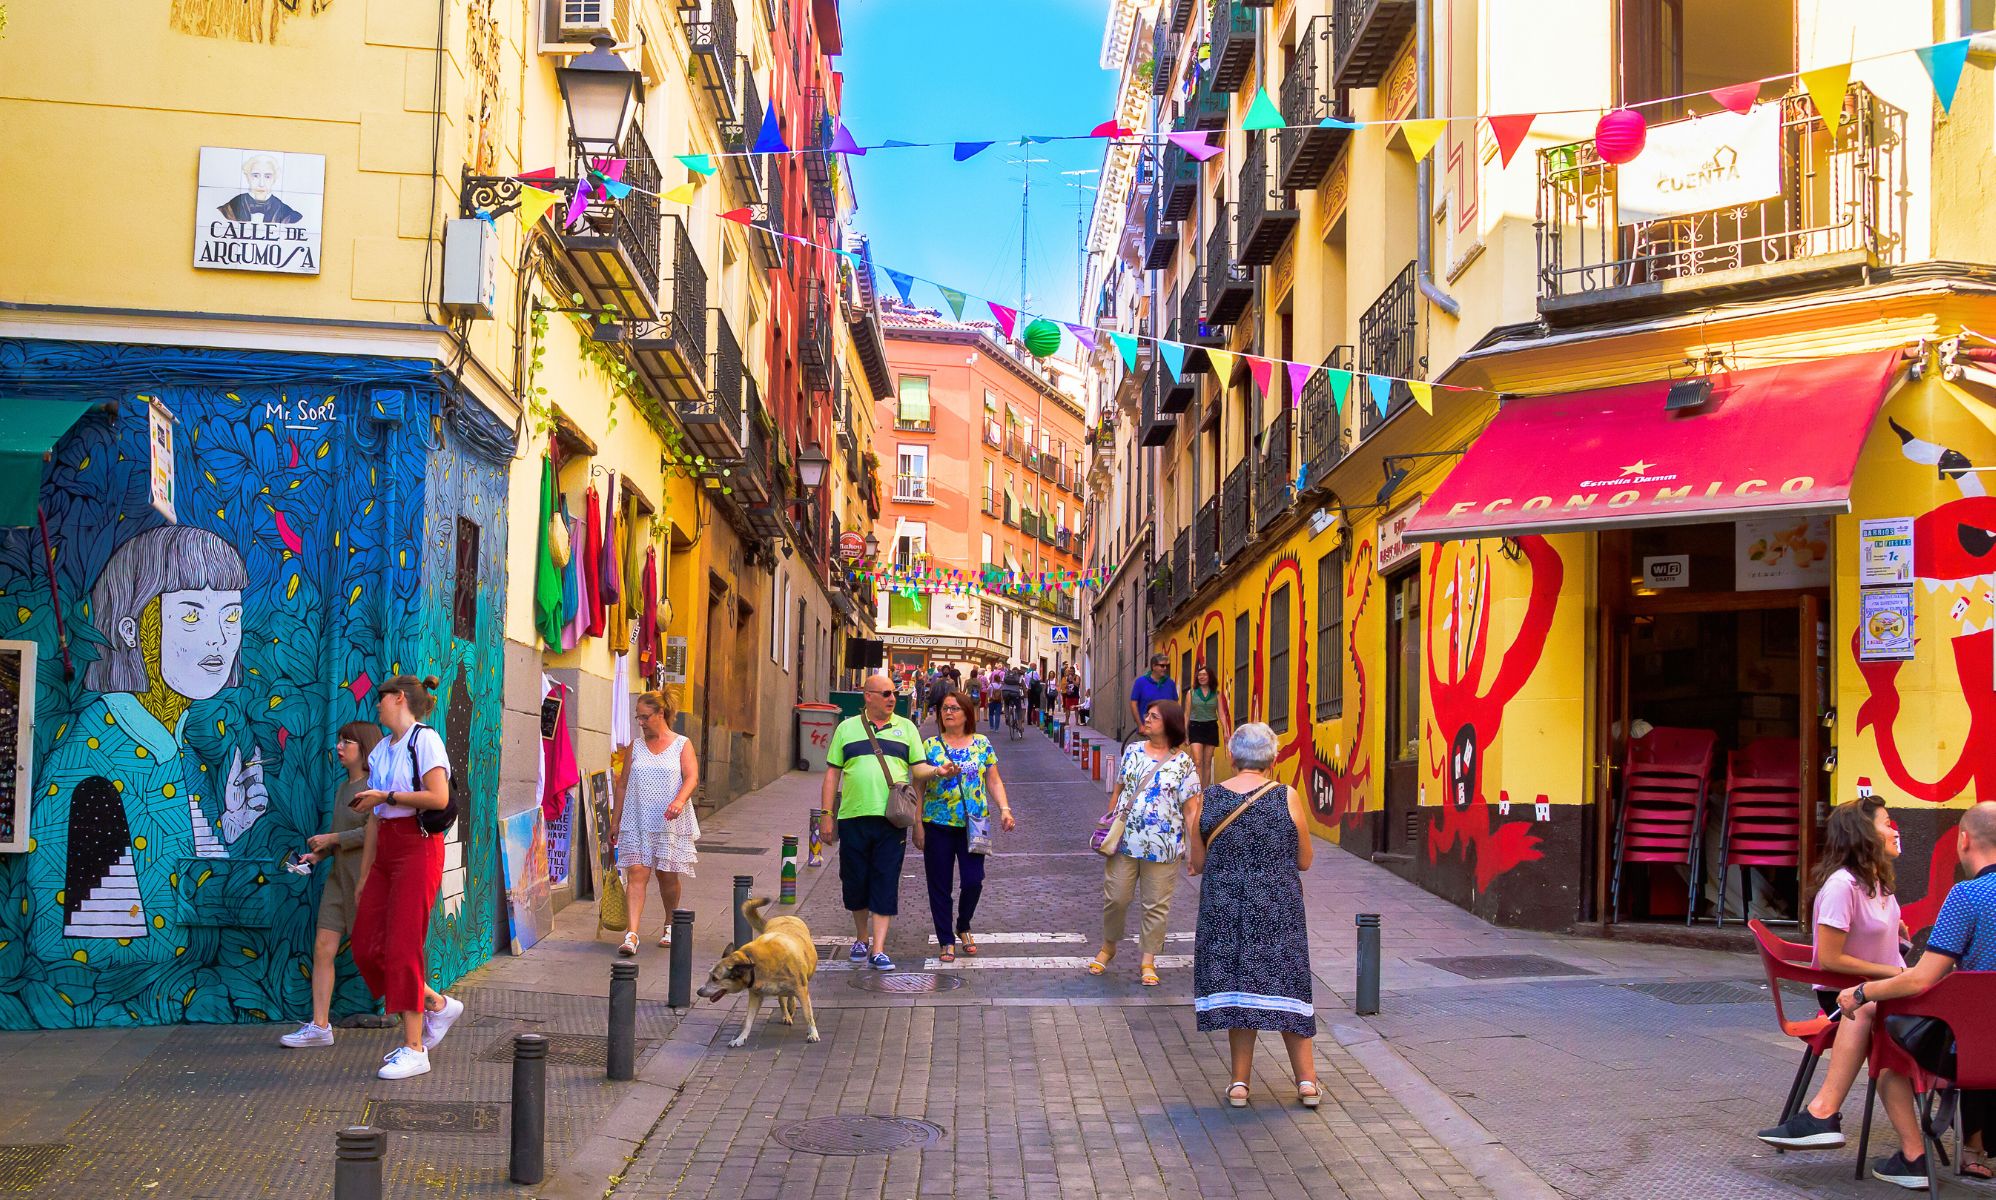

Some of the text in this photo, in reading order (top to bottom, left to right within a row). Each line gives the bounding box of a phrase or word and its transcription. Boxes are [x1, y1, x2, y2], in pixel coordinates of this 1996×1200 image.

[1656, 164, 1741, 194] CUENTA
[210, 221, 309, 241] CALLE DE
[266, 402, 292, 420] Mr.
[1580, 474, 1677, 488] Estrella Damm
[1441, 476, 1815, 520] ECONOMICO
[1862, 527, 1895, 538] BARRIOS
[892, 636, 939, 645] LORENZO
